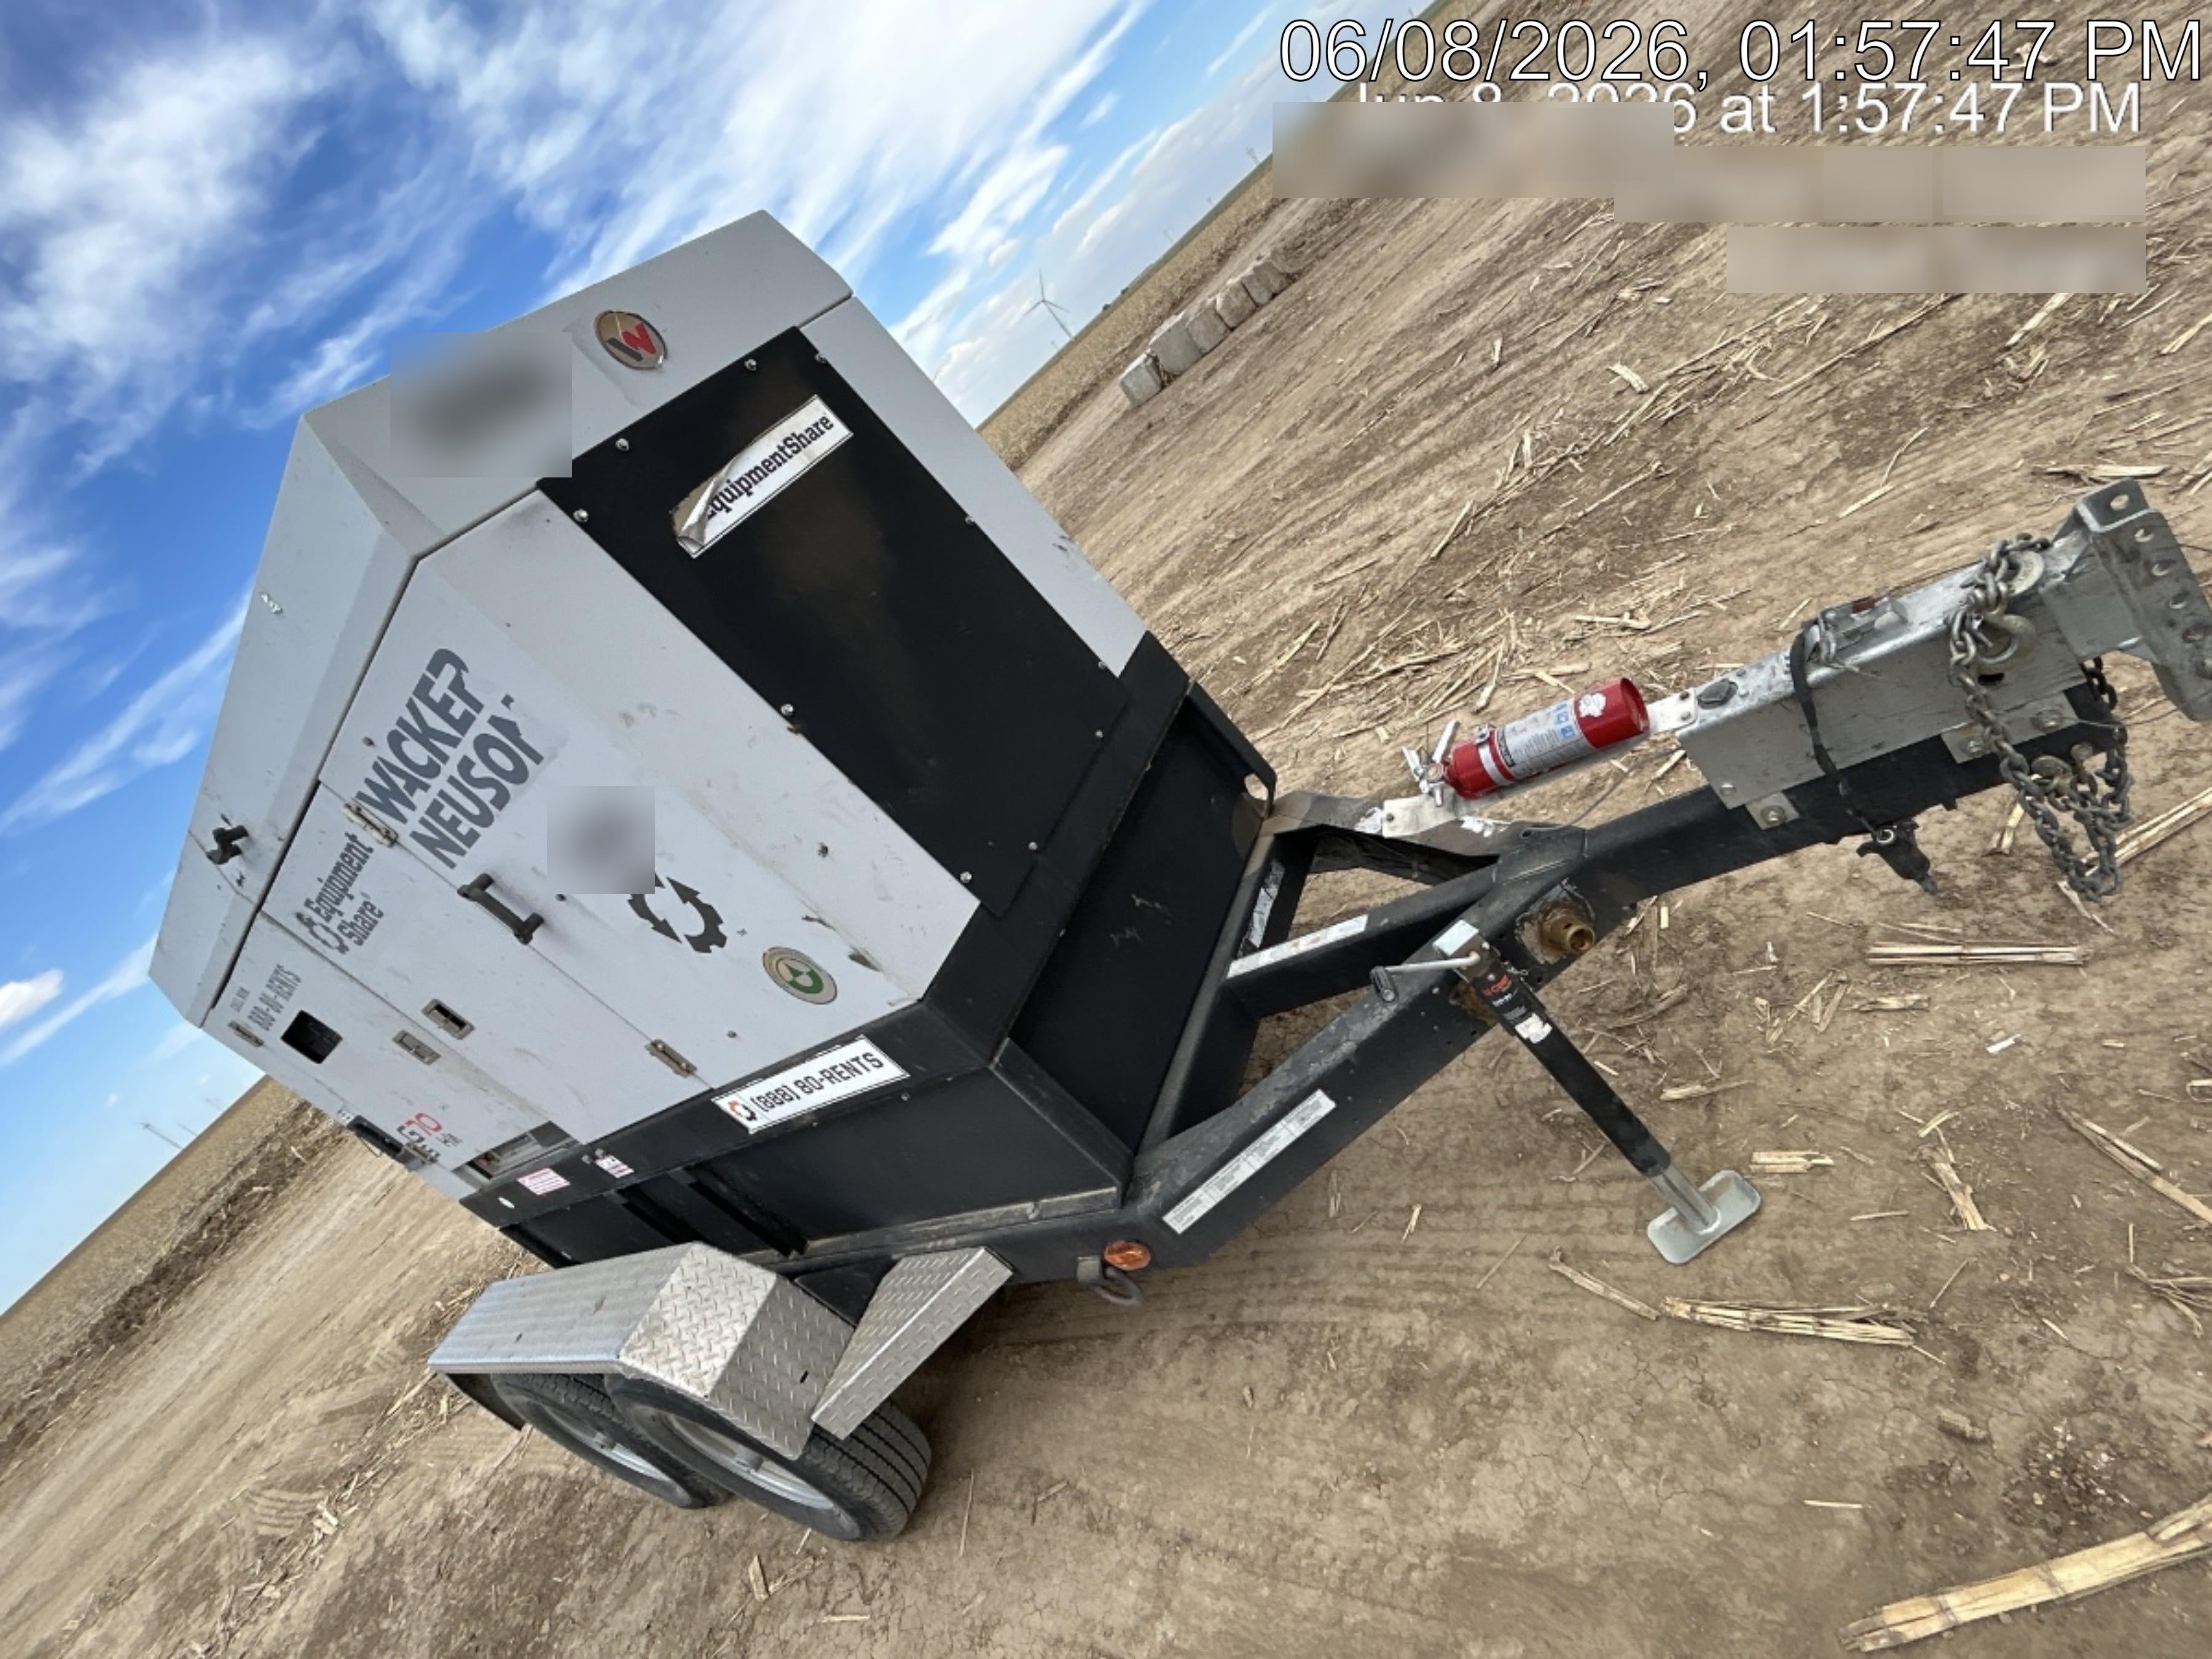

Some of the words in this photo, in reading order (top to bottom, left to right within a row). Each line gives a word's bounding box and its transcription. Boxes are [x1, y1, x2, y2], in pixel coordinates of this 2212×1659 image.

[356, 648, 485, 825] WACKER
[304, 831, 373, 924] Equipment
[337, 899, 384, 946] Share
[750, 1083, 801, 1113] (888)
[798, 1051, 885, 1095] 80-RENTS
